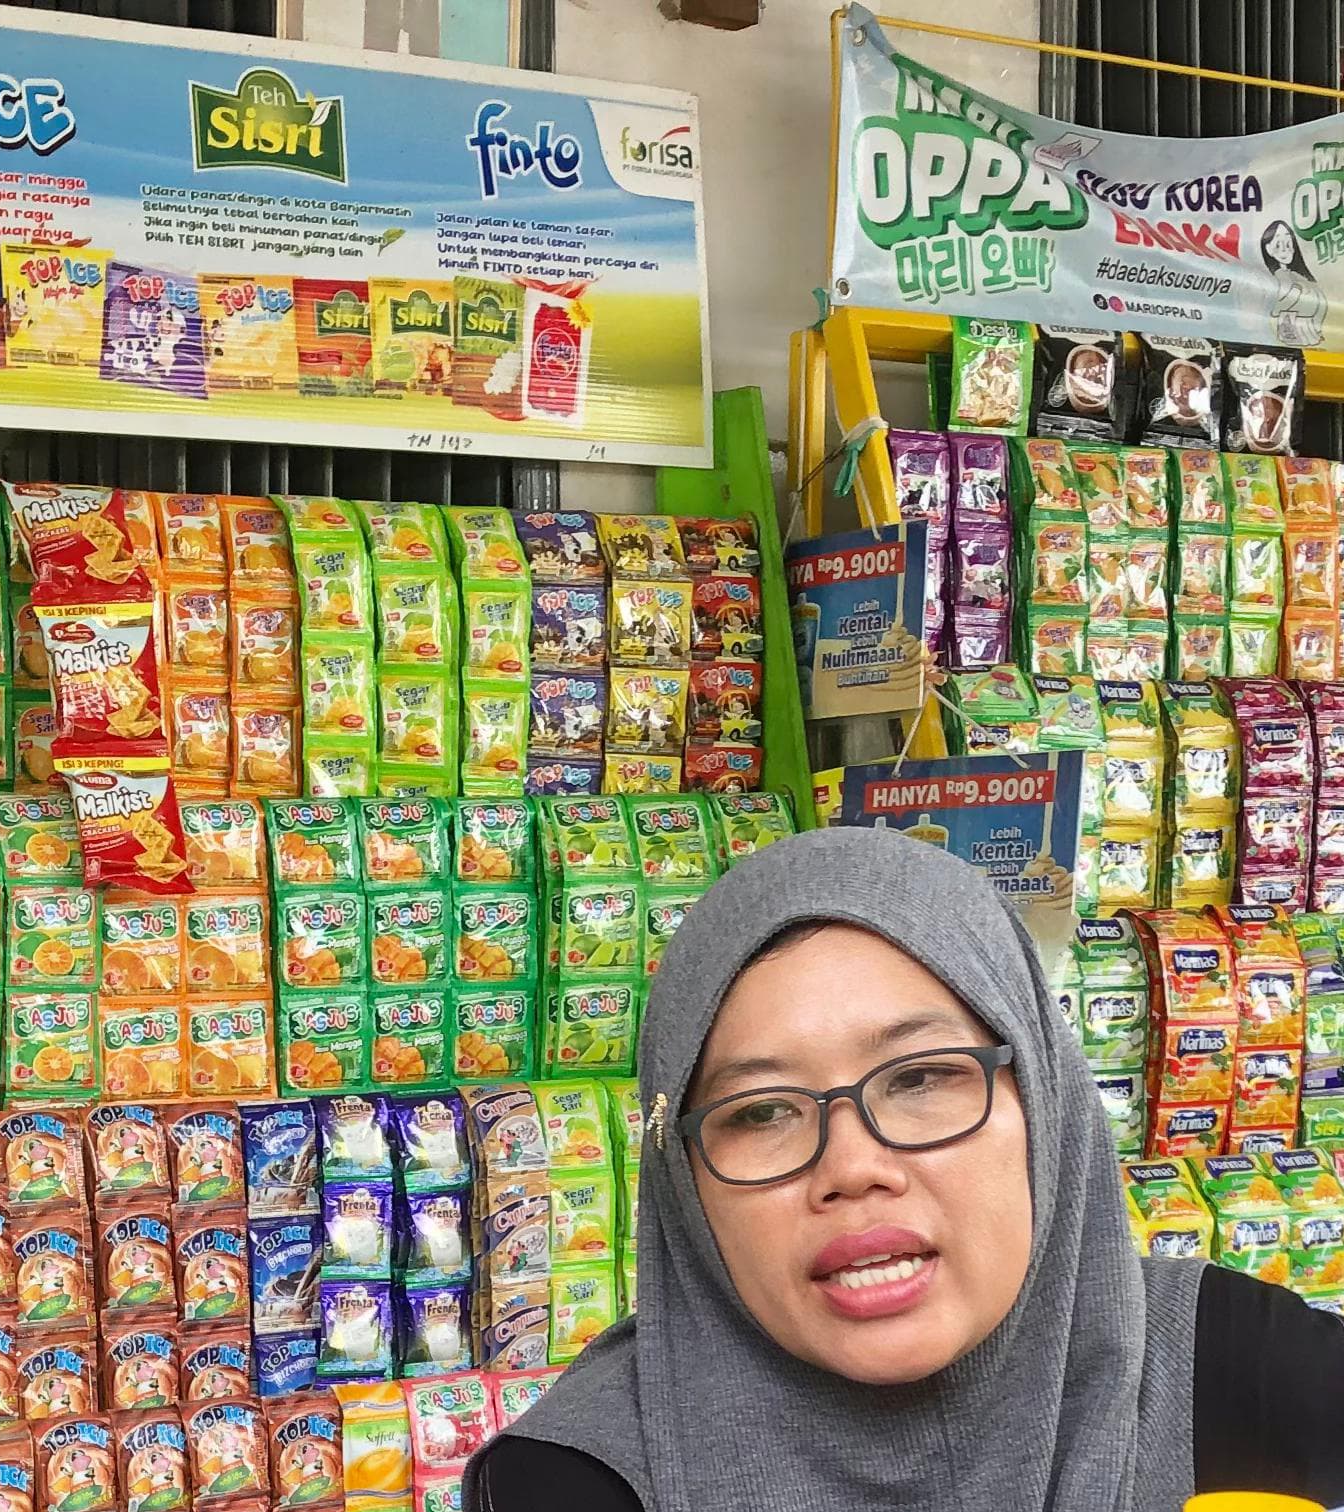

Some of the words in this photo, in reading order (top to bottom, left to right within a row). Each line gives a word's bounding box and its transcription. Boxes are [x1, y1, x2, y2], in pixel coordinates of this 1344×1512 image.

[248, 84, 287, 107] Teh
[207, 102, 332, 159] Sisri
[467, 99, 583, 200] finto
[619, 126, 693, 169] forisa
[28, 172, 87, 191] minggu
[859, 127, 1073, 225] OPPA
[22, 190, 91, 208] rasanya
[141, 184, 187, 199] Udara
[190, 190, 276, 208] panas/dingin
[279, 196, 291, 208] di
[294, 197, 327, 211] kota
[329, 201, 413, 218] Banjarmasin
[1075, 168, 1162, 210] SUSU
[1166, 174, 1264, 214] KOREA
[14, 208, 55, 225] ragu
[144, 215, 173, 229] Jika
[175, 218, 208, 232] ingin
[212, 219, 237, 234] beli
[239, 224, 300, 239] minuman
[303, 229, 386, 246] panas/dingin
[224, 206, 260, 220] tebal
[262, 210, 329, 226] berbahan
[331, 215, 360, 228] kain
[436, 212, 472, 226] Jalan
[473, 214, 509, 231] jalan
[511, 217, 527, 230] ke
[529, 218, 572, 234] taman
[145, 231, 175, 244] Pilih
[177, 233, 206, 248] TEH
[251, 239, 300, 255] jangan
[302, 242, 336, 259] yang
[338, 246, 365, 259] lain
[436, 228, 486, 246] Jangan
[488, 231, 518, 248] lupa
[1111, 208, 1219, 262] ENAK
[437, 241, 479, 257] Untuk
[480, 245, 581, 269] membangkitkan
[583, 252, 636, 274] percaya
[639, 259, 660, 272] diri
[438, 257, 480, 274] Minum
[482, 259, 524, 277] FINTO
[526, 263, 565, 281] setiap
[567, 267, 595, 281] hari
[894, 236, 969, 304] 마리
[1096, 256, 1232, 298] #daebaksusunya
[1125, 301, 1204, 321] MARIOPPA.ID
[838, 611, 892, 636] Kental,
[54, 641, 133, 677] Malkist
[76, 790, 154, 820] Malkist
[872, 782, 942, 809] HANYA
[990, 827, 1021, 840] Lebih
[971, 841, 1038, 863] Kental,
